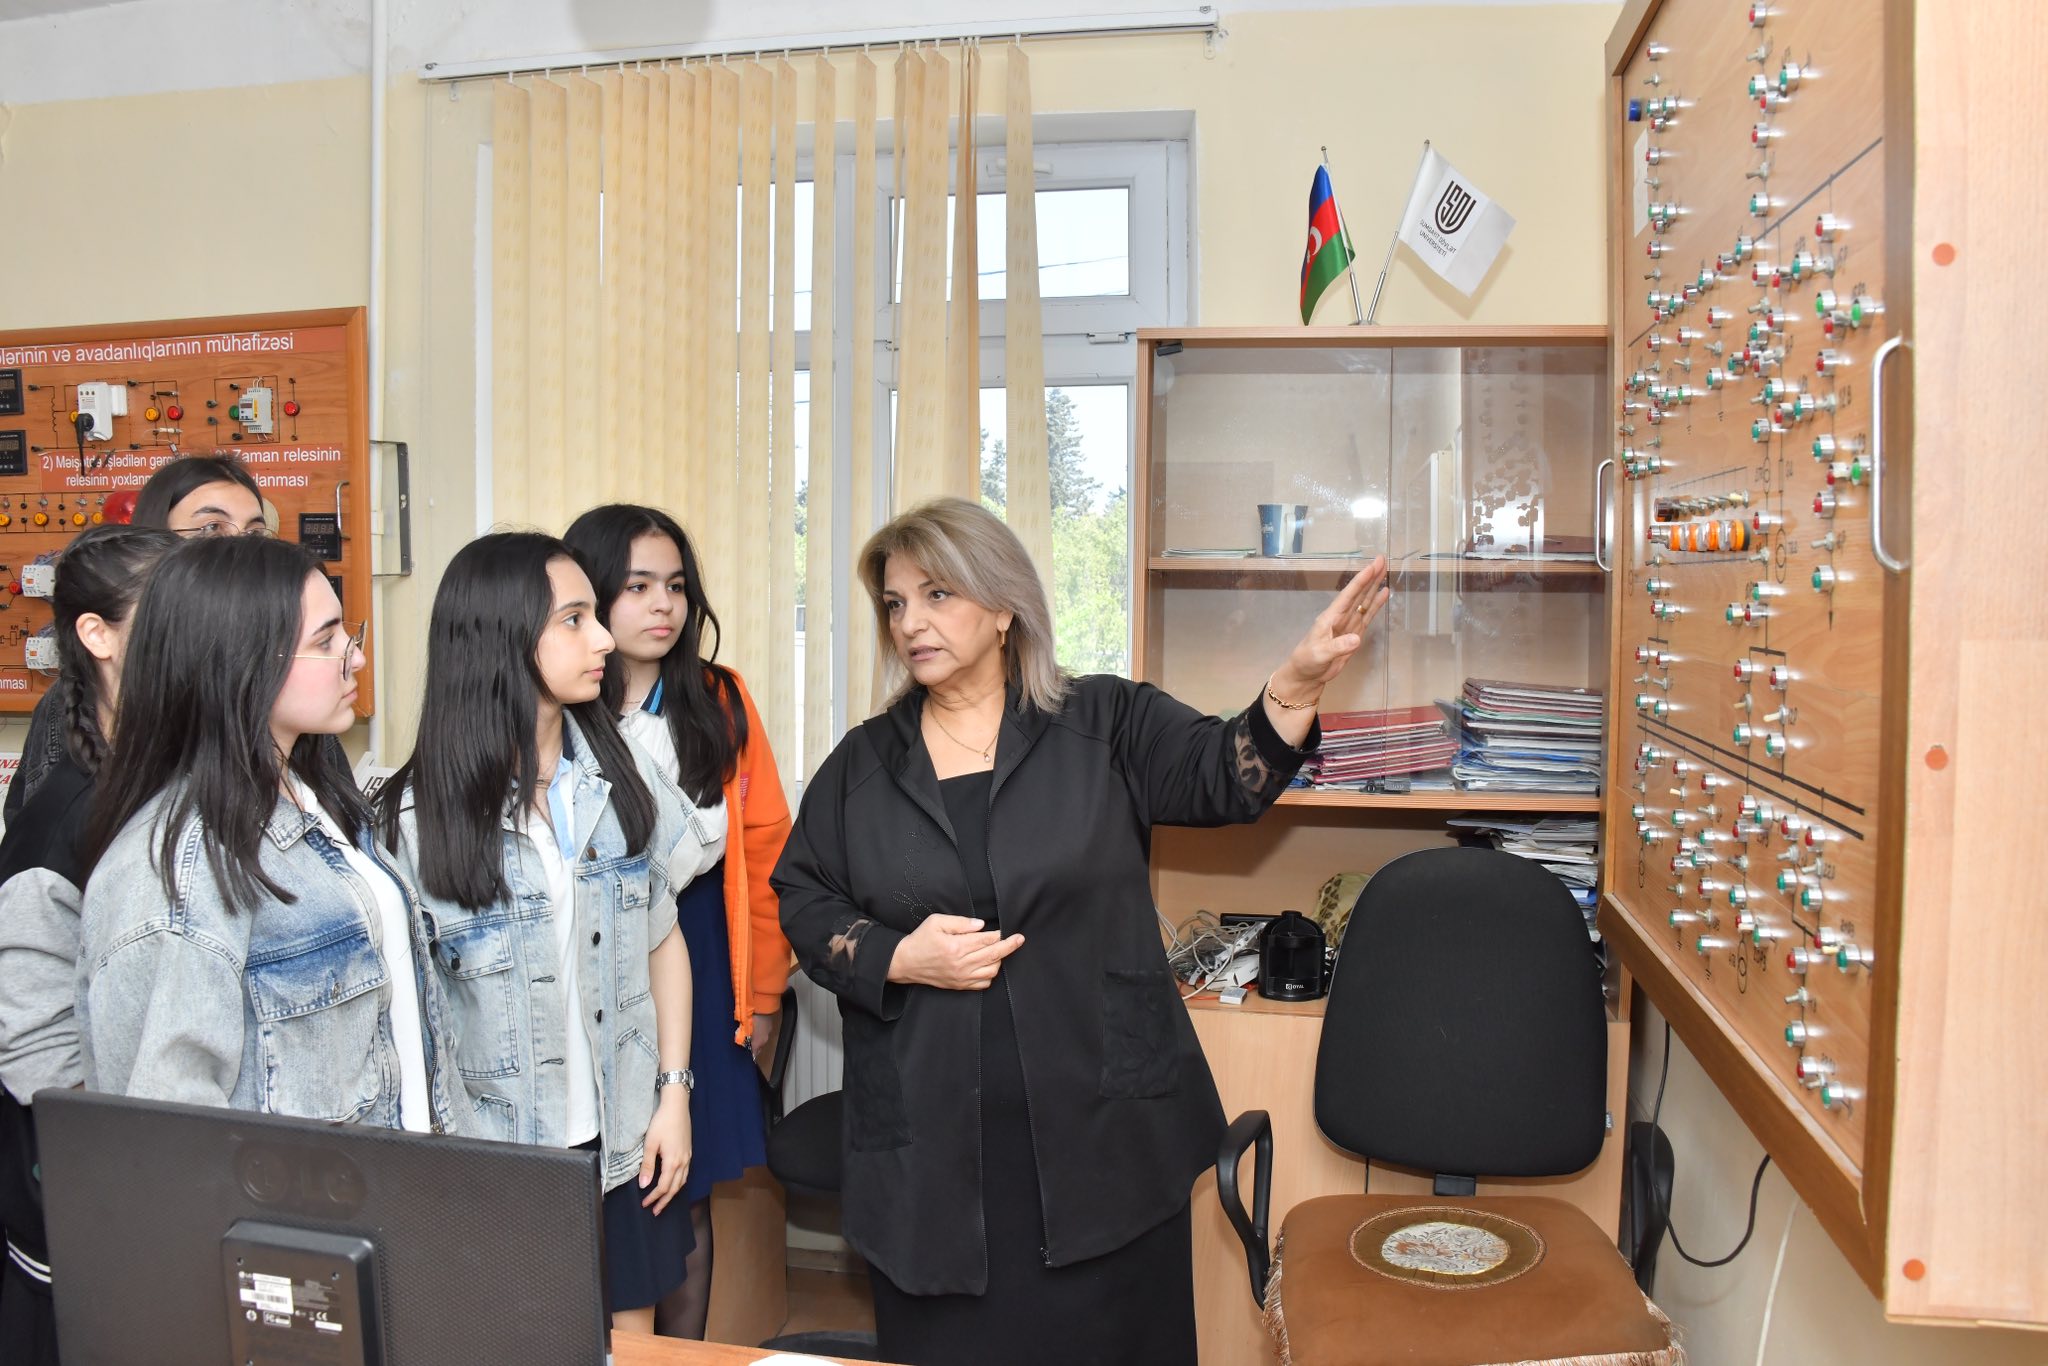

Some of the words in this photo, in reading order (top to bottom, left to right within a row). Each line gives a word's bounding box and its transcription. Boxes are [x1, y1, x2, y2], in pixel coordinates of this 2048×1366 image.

[0, 347, 48, 365] lərinin
[52, 348, 71, 362] və
[75, 341, 201, 362] avadanlıqlarının
[206, 332, 294, 353] mühafizəsi
[232, 448, 280, 463] Zaman
[283, 446, 341, 463] relesinin
[42, 456, 54, 472] 2)
[65, 474, 109, 487] relesinin
